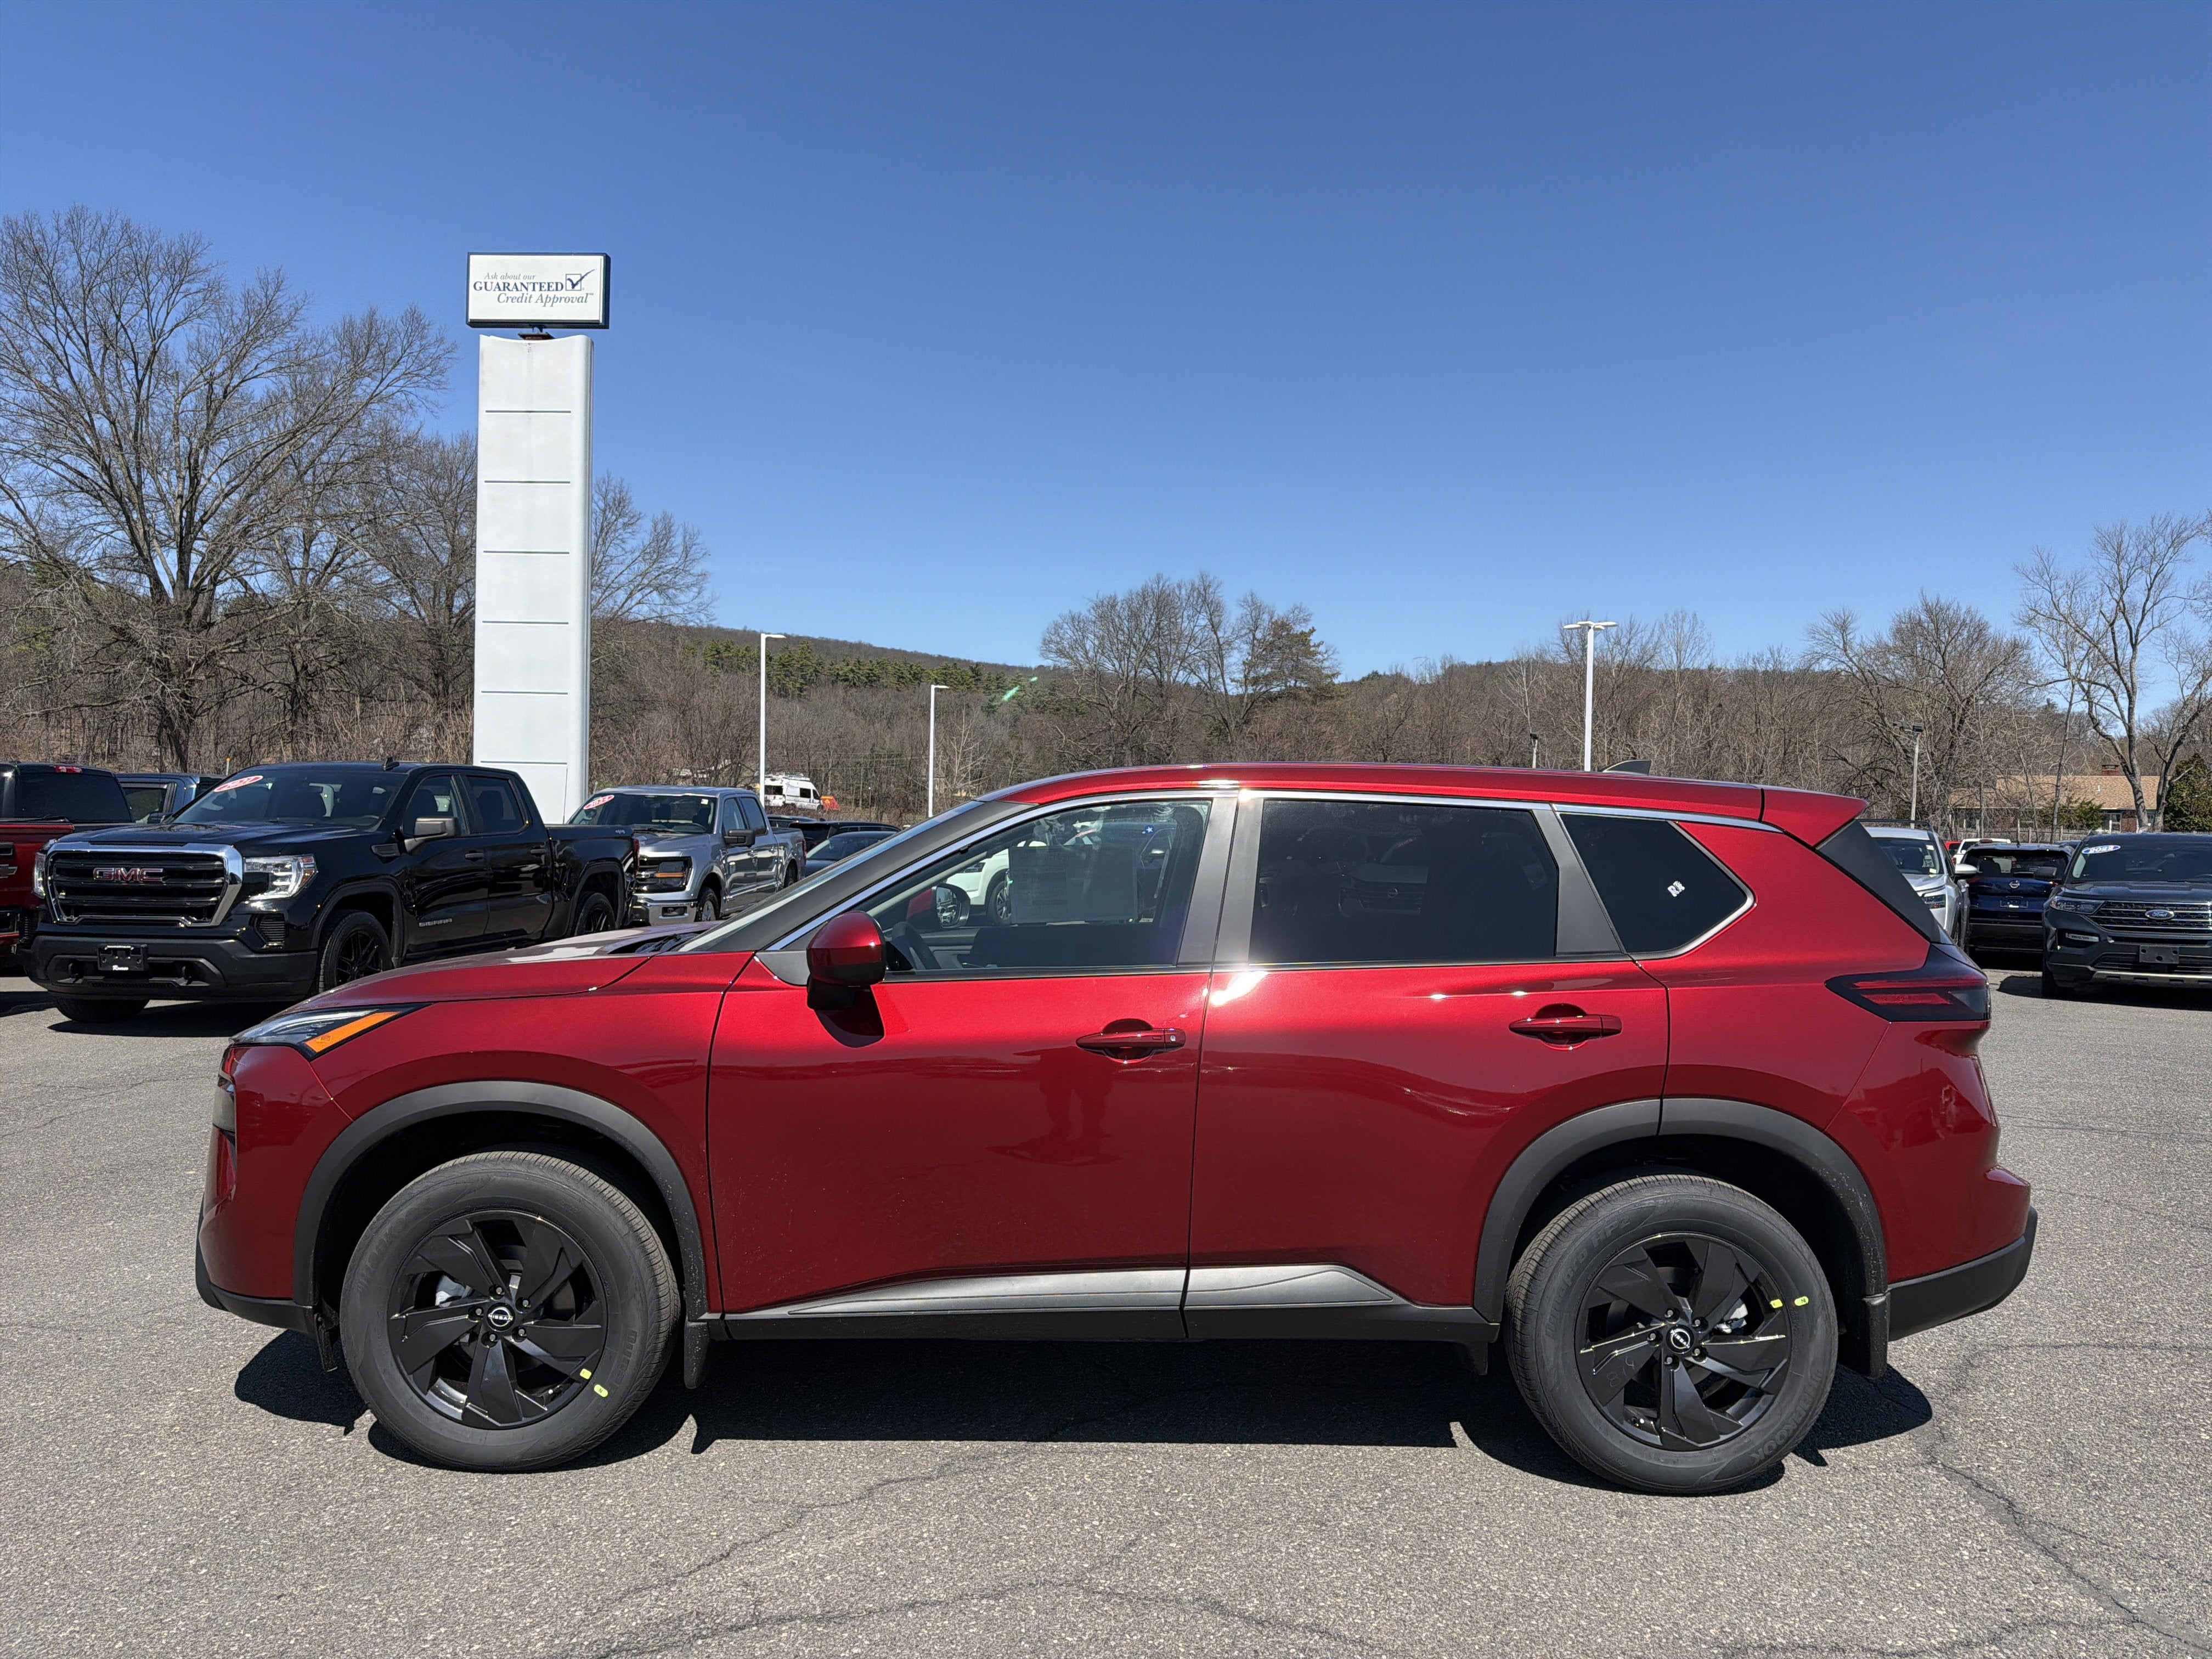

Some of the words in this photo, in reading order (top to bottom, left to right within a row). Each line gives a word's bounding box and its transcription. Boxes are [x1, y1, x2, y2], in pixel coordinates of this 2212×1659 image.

[473, 281, 564, 292] GUARANTEED
[497, 293, 533, 303] Credit
[93, 867, 164, 882] GMC
[419, 918, 453, 927] SIERRA
